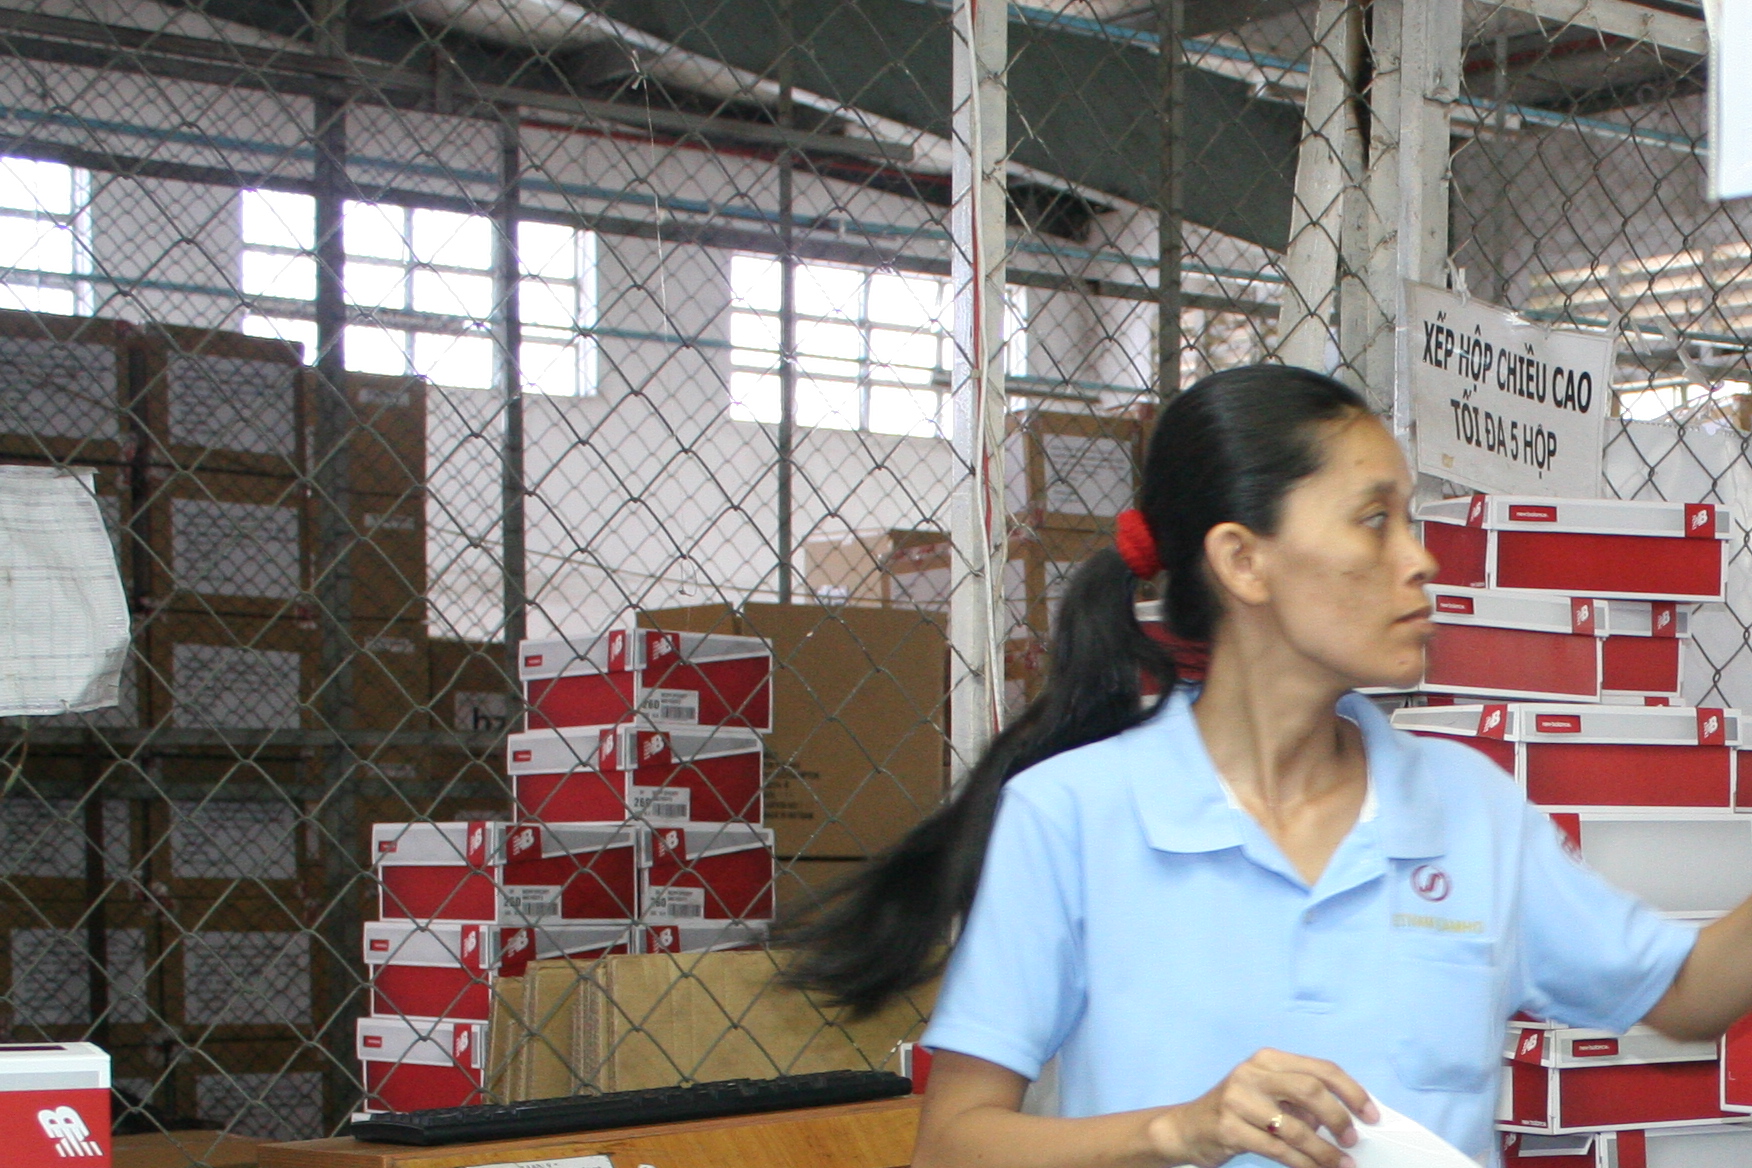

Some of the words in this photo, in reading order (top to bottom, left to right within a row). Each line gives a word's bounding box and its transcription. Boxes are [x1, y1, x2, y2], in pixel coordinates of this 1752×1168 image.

[1423, 310, 1454, 370] XẾP
[1459, 324, 1493, 392] HỘP
[1497, 343, 1547, 403] CHIỀU
[1552, 366, 1592, 413] CAO
[1451, 389, 1482, 447] TỐI
[1484, 411, 1508, 458] ĐA
[1511, 421, 1519, 460] 5
[1523, 424, 1557, 479] HỘP
